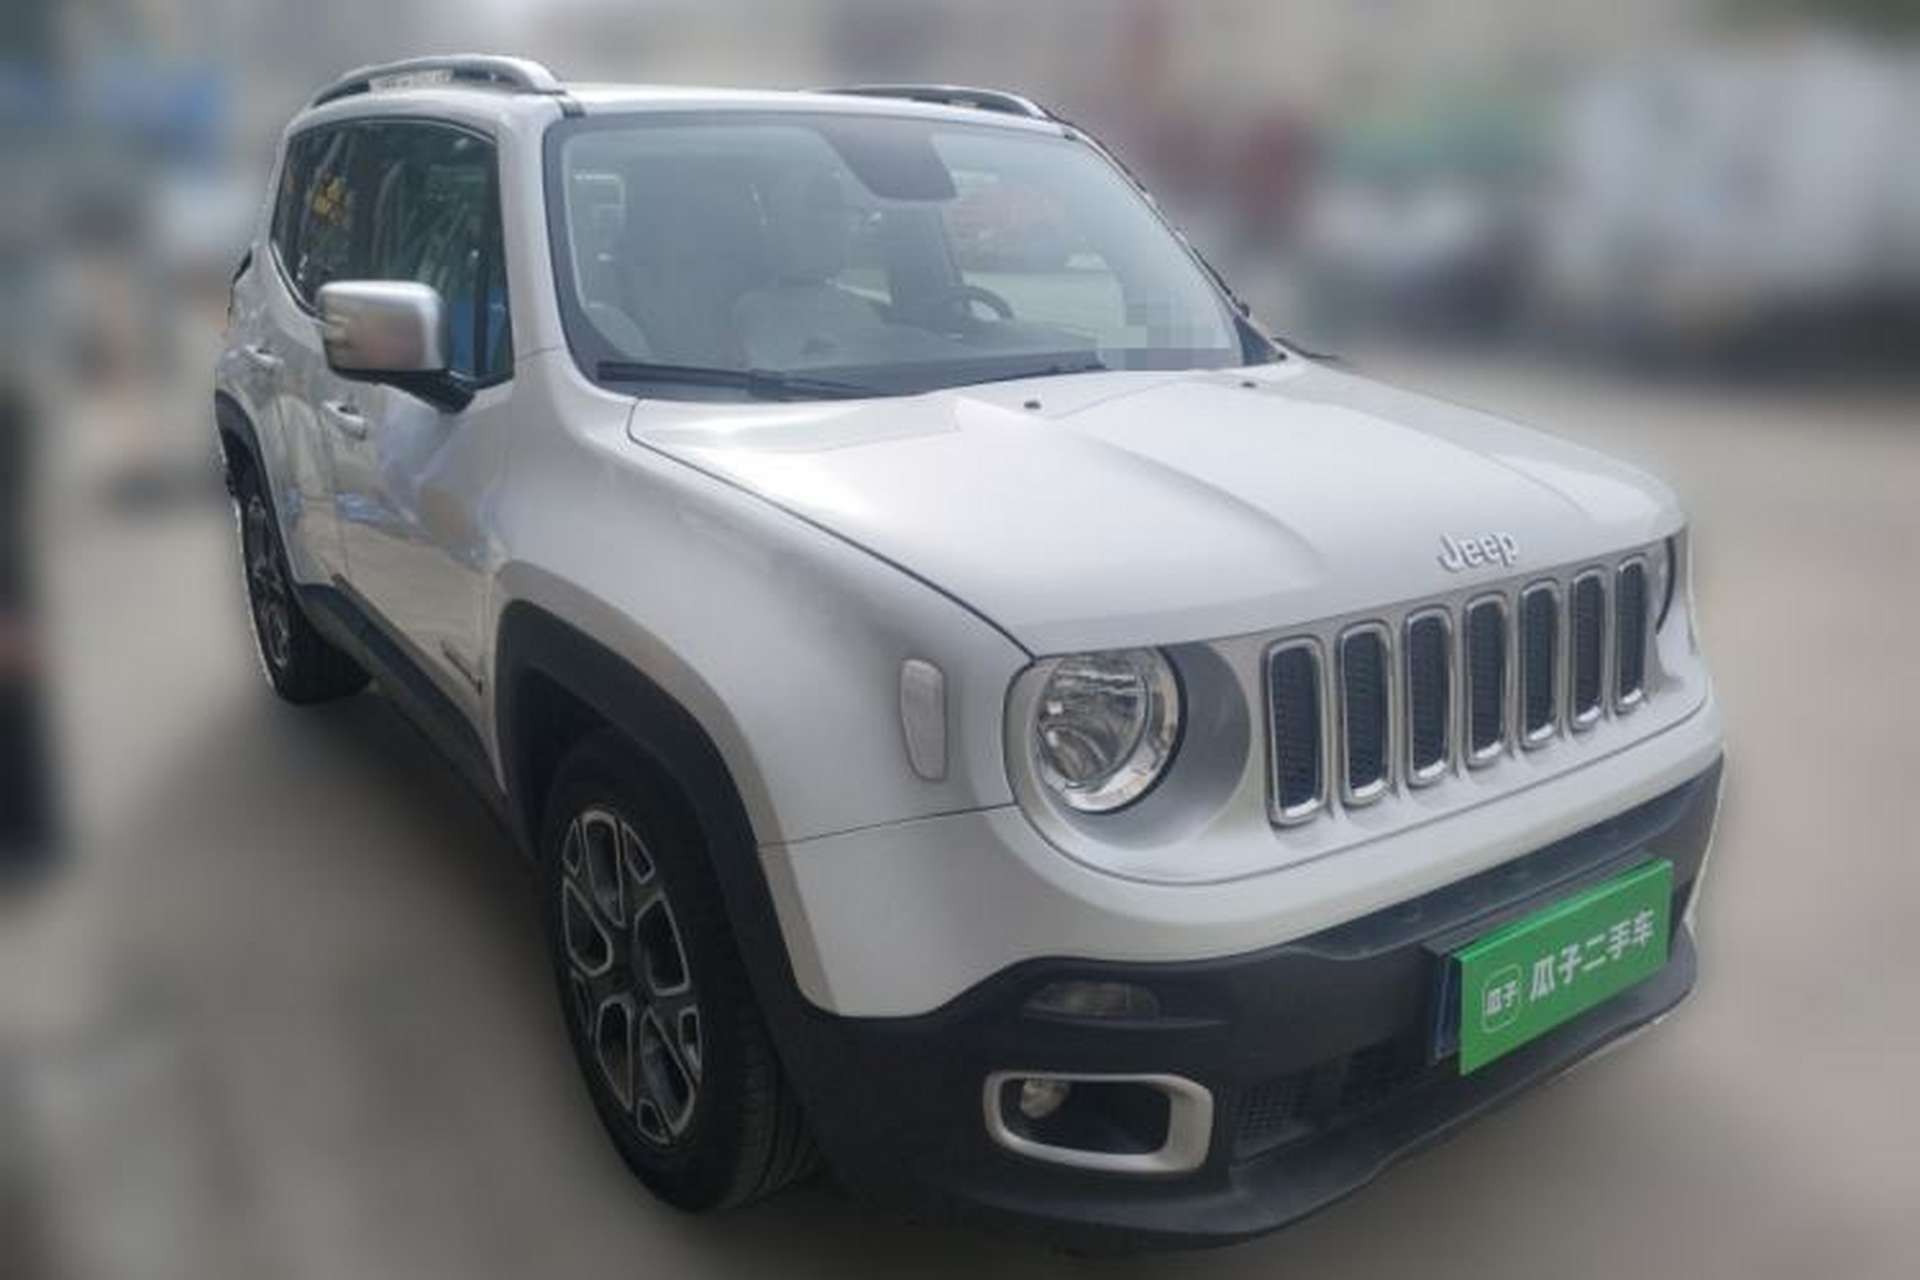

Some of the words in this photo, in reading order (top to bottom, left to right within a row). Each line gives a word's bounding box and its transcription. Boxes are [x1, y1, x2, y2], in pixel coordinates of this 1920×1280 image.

[1437, 531, 1519, 572] Jeep
[1530, 910, 1654, 1002] 瓜子二手车
